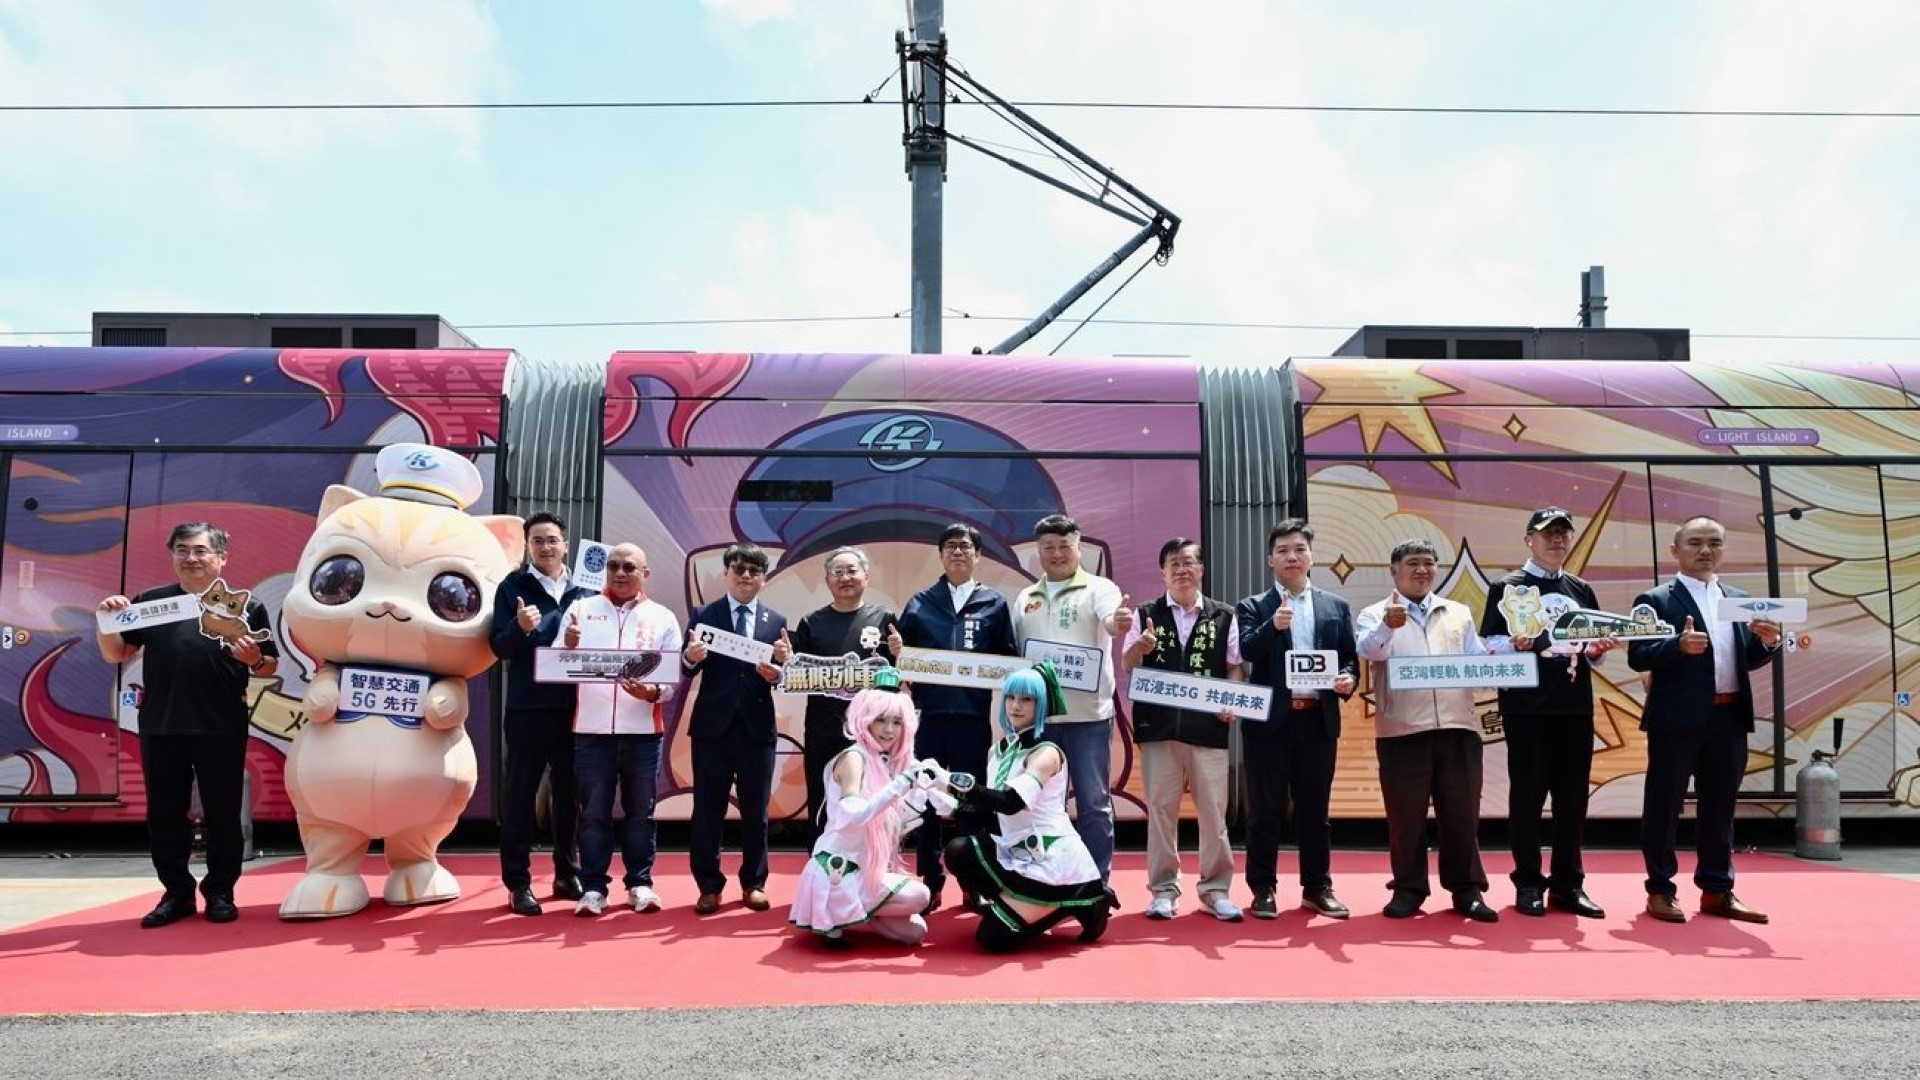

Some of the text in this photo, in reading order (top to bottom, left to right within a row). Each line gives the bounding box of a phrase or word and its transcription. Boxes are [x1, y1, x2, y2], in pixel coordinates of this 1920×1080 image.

[7, 427, 53, 438] ISLAND
[1718, 432, 1798, 443] LIGHT ISLAND
[1398, 662, 1525, 680] 亞灣輕軌 航向未來
[350, 673, 420, 694] 智慧交通
[351, 691, 418, 712] 5G 先行
[1135, 677, 1265, 710] 沉浸式5G 共創未來
